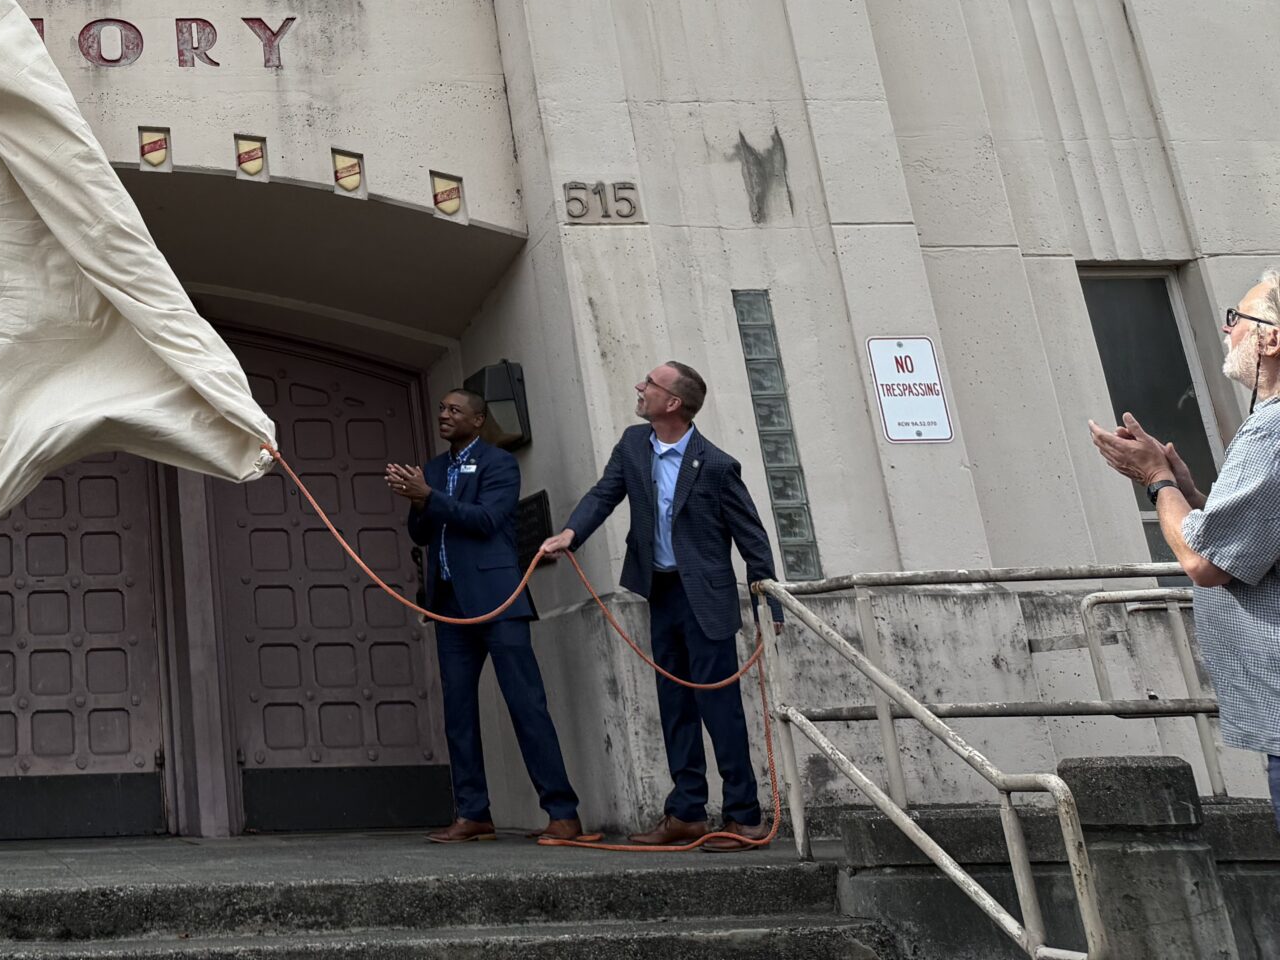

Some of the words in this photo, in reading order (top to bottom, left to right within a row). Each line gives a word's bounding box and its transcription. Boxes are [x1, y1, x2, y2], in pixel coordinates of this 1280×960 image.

[563, 181, 637, 218] 515
[894, 354, 915, 374] NO
[880, 382, 940, 397] TRESPASSING
